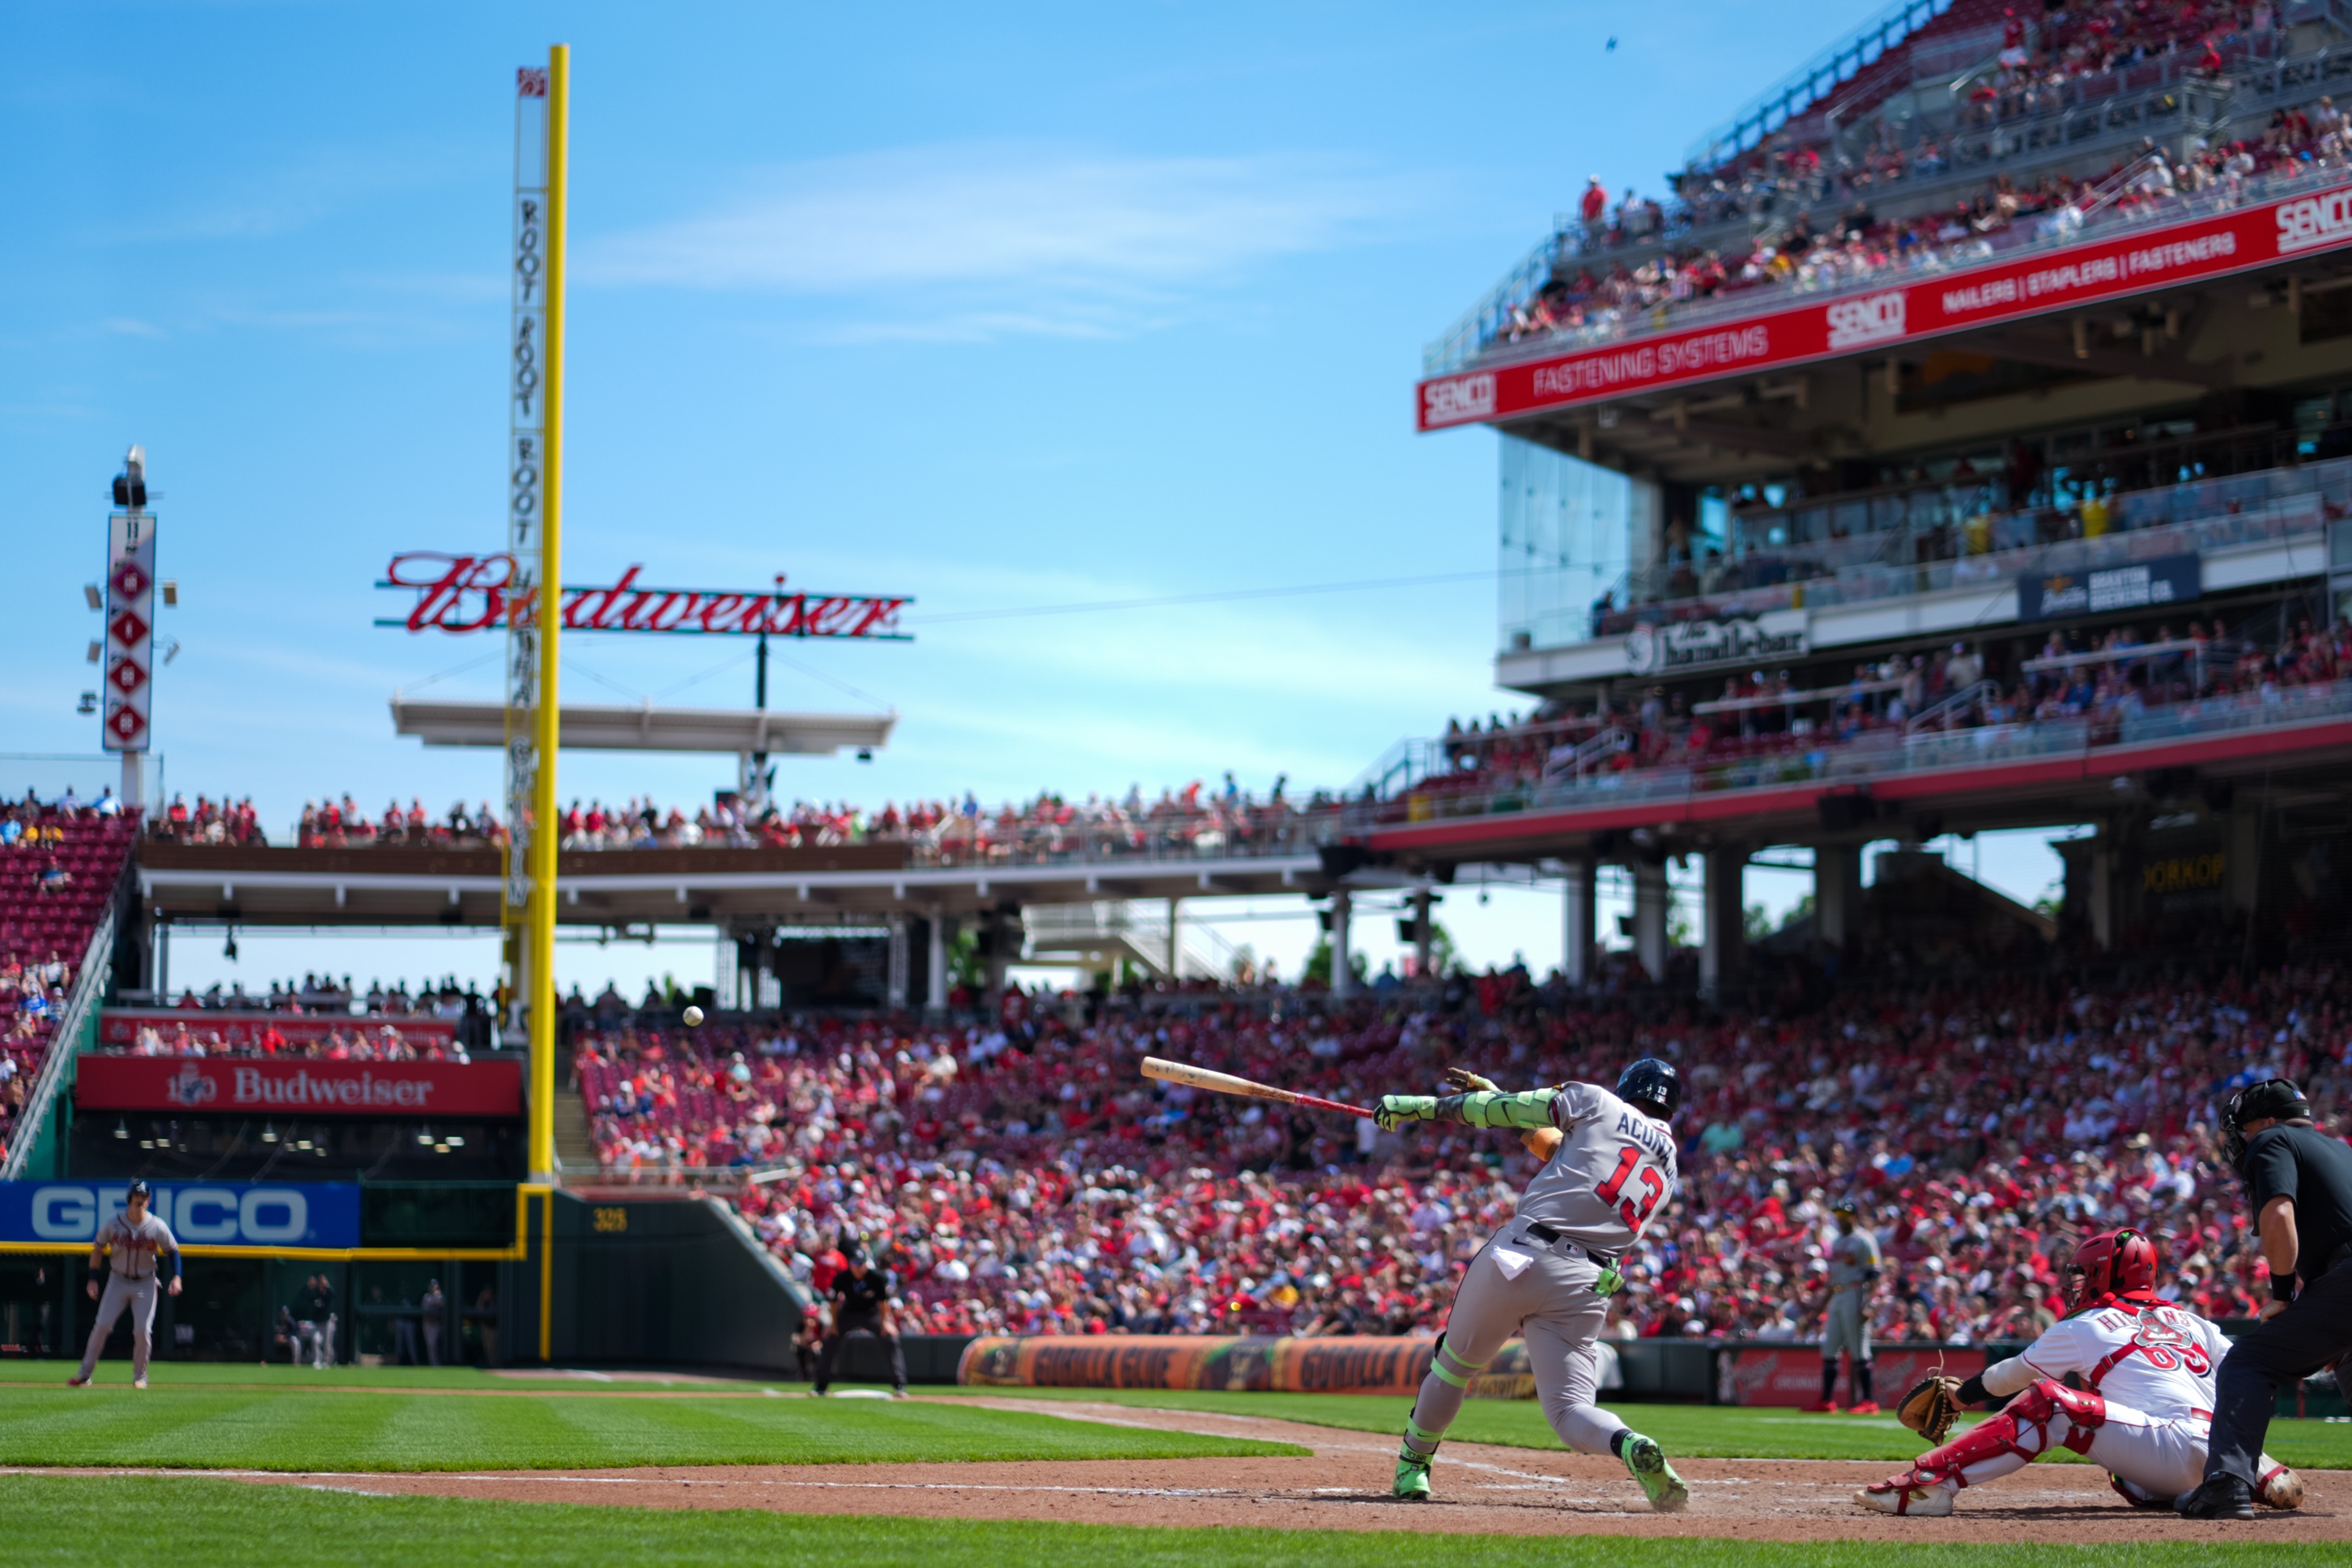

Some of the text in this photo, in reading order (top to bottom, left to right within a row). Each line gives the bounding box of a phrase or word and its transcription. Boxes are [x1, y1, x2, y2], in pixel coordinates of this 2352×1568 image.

[1942, 231, 2237, 315] NAILERS STAPLERS FASTENERS
[1826, 292, 1907, 340] SENCO
[1533, 325, 1770, 398] FASTENING SYSTEMS
[1423, 374, 1497, 418] SENCO
[233, 1066, 434, 1106] Budweiser
[1657, 1085, 1668, 1096] 13
[1594, 1145, 1665, 1234] 13
[2097, 1309, 2191, 1332] HIGNS
[1301, 1345, 1403, 1388] GORILLA
